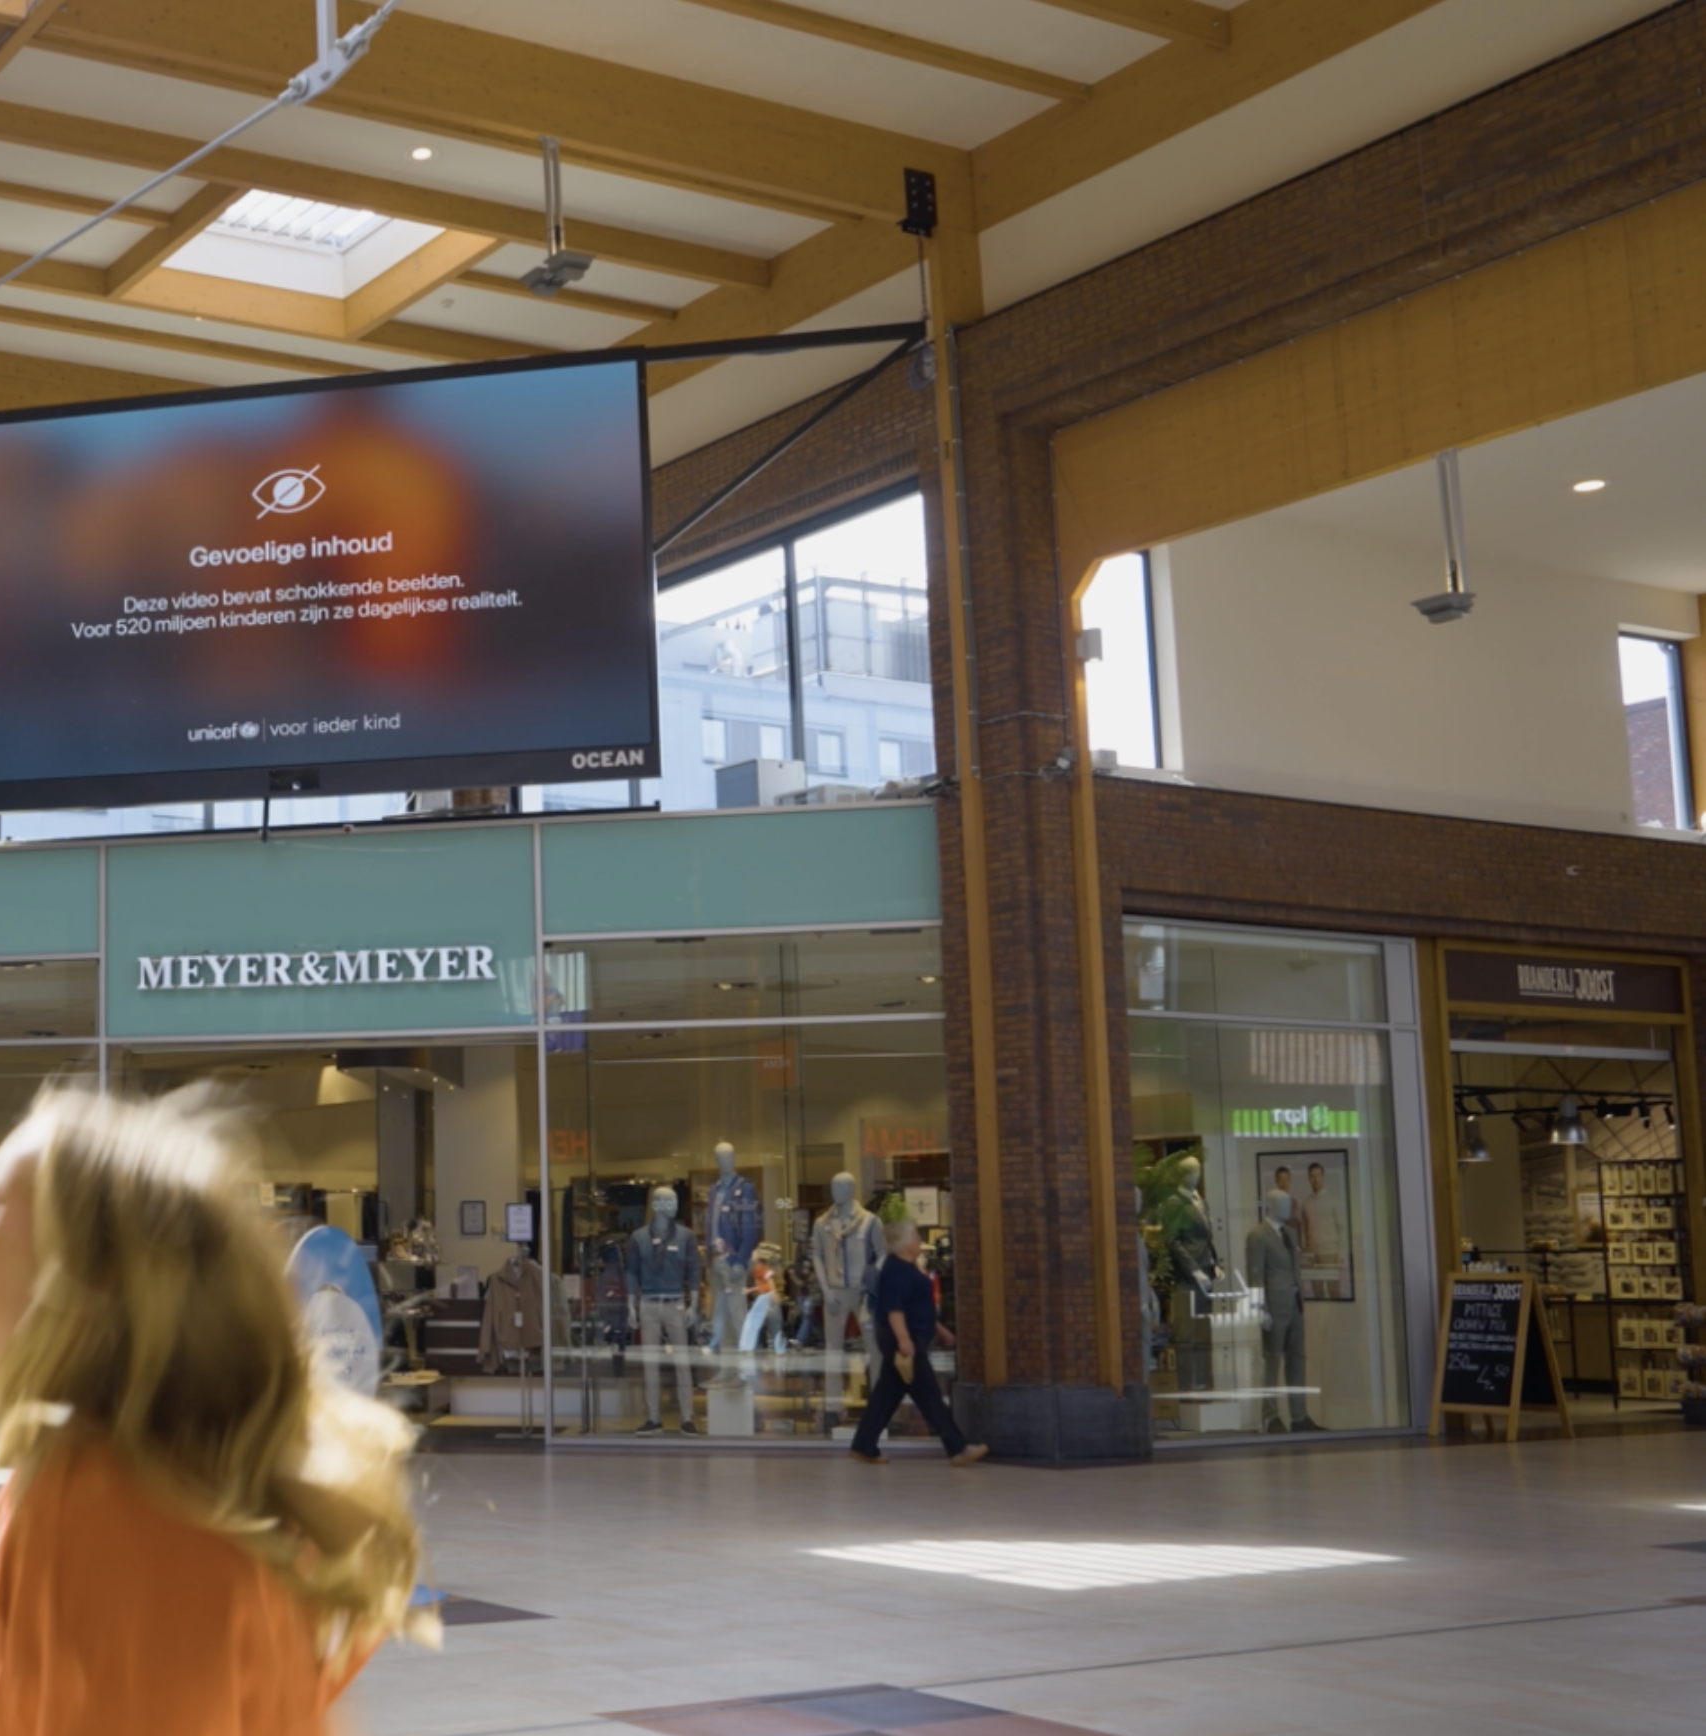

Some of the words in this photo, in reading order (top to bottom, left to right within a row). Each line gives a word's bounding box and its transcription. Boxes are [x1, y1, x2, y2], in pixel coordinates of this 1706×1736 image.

[189, 540, 306, 567] Gevoelige
[311, 531, 393, 558] inhoud
[124, 596, 169, 614] Deze
[171, 592, 220, 610] video
[223, 587, 272, 606] bevat
[275, 578, 384, 602] schokkende
[387, 573, 465, 593] beelden.
[71, 622, 112, 639] Voor
[115, 616, 152, 636] 520
[155, 614, 217, 634] miljoen
[220, 607, 295, 627] kinderen
[299, 603, 330, 625] zijn
[333, 605, 355, 619] ze
[358, 596, 448, 619] dagelijkse
[452, 589, 523, 611] realiteit.
[187, 722, 240, 742] unicef
[269, 721, 309, 737] voor
[313, 716, 358, 734] ieder
[363, 712, 402, 731] kind
[571, 749, 645, 769] OCEAN
[137, 945, 497, 990] MEYER&MEYER
[1574, 968, 1616, 1003] JOOST
